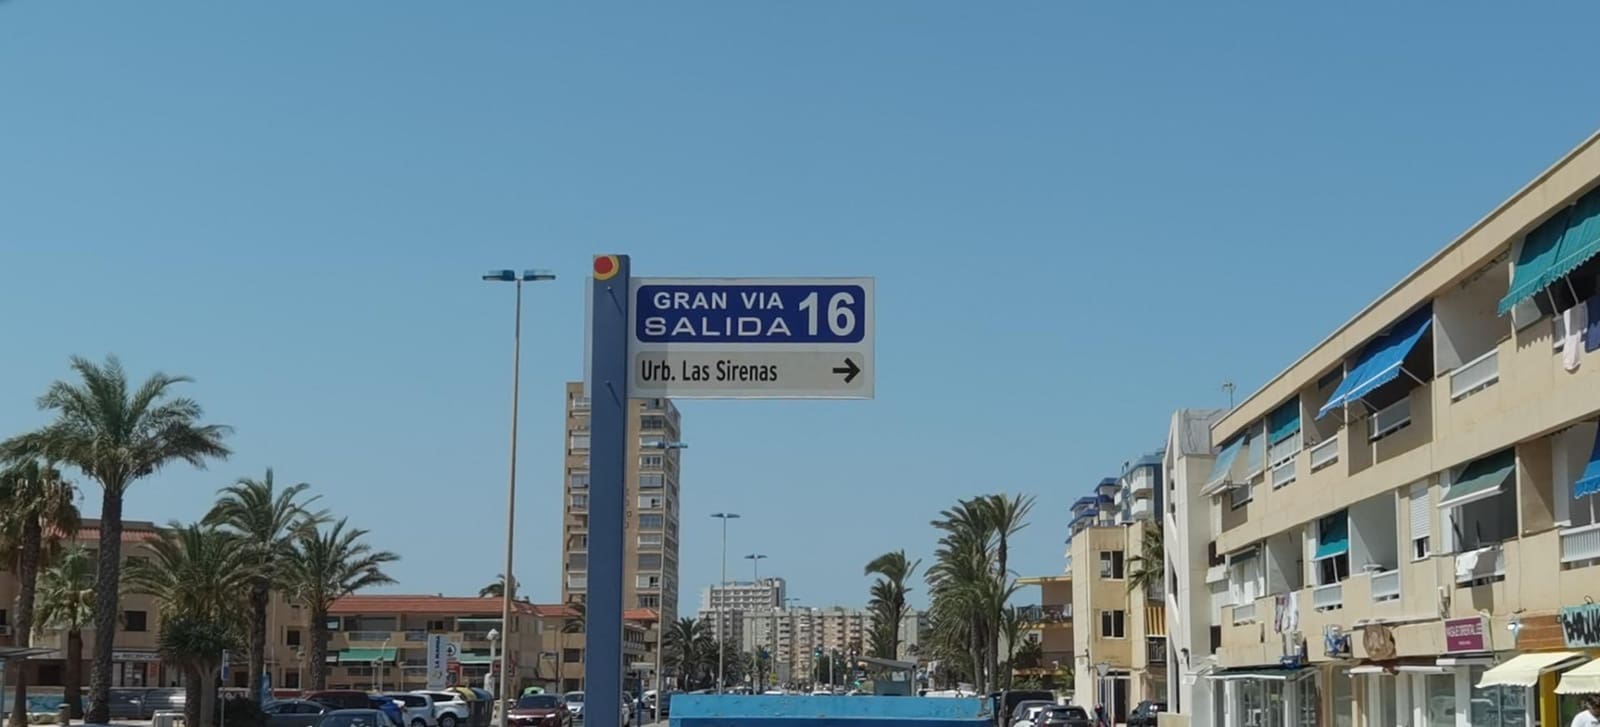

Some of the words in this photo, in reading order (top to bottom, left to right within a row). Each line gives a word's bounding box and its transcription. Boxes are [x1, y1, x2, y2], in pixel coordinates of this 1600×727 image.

[653, 292, 727, 310] GRAN
[741, 292, 784, 310] VIA
[799, 291, 856, 336] 16
[644, 317, 792, 336] SALIDA
[641, 360, 676, 382] Urb.
[682, 360, 710, 382] Las
[716, 360, 778, 382] Sirenas
